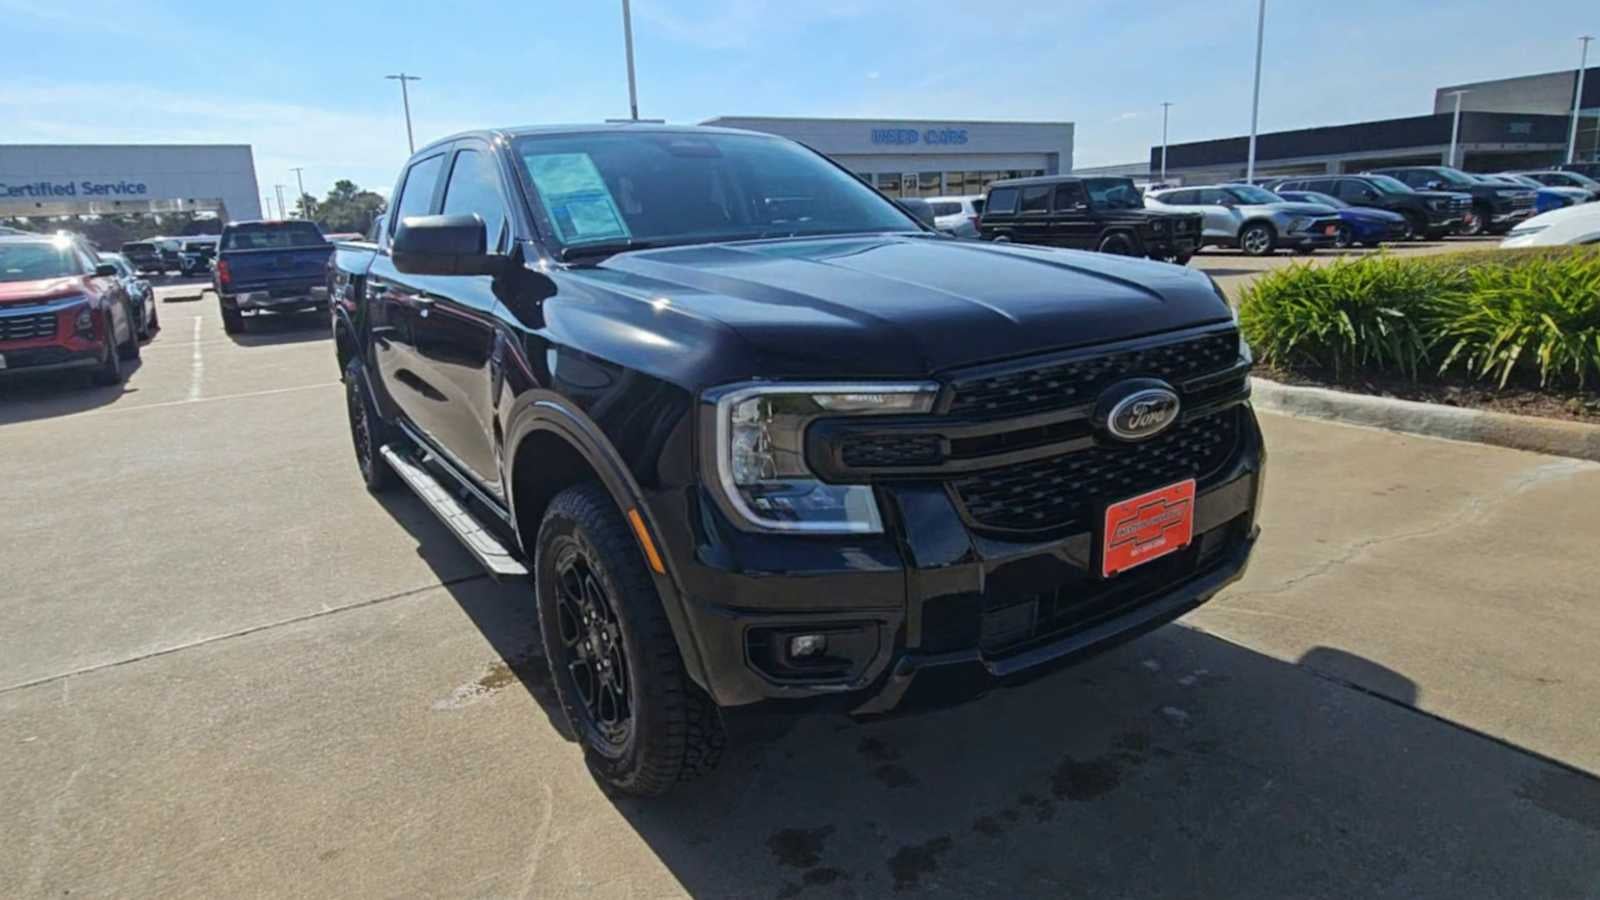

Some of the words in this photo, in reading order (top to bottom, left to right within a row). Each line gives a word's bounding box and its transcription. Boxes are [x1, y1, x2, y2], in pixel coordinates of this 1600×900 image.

[871, 127, 920, 145] USED
[923, 127, 969, 145] CARS
[0, 181, 76, 197] Certified
[81, 181, 147, 196] Service
[1128, 399, 1168, 430] Ford
